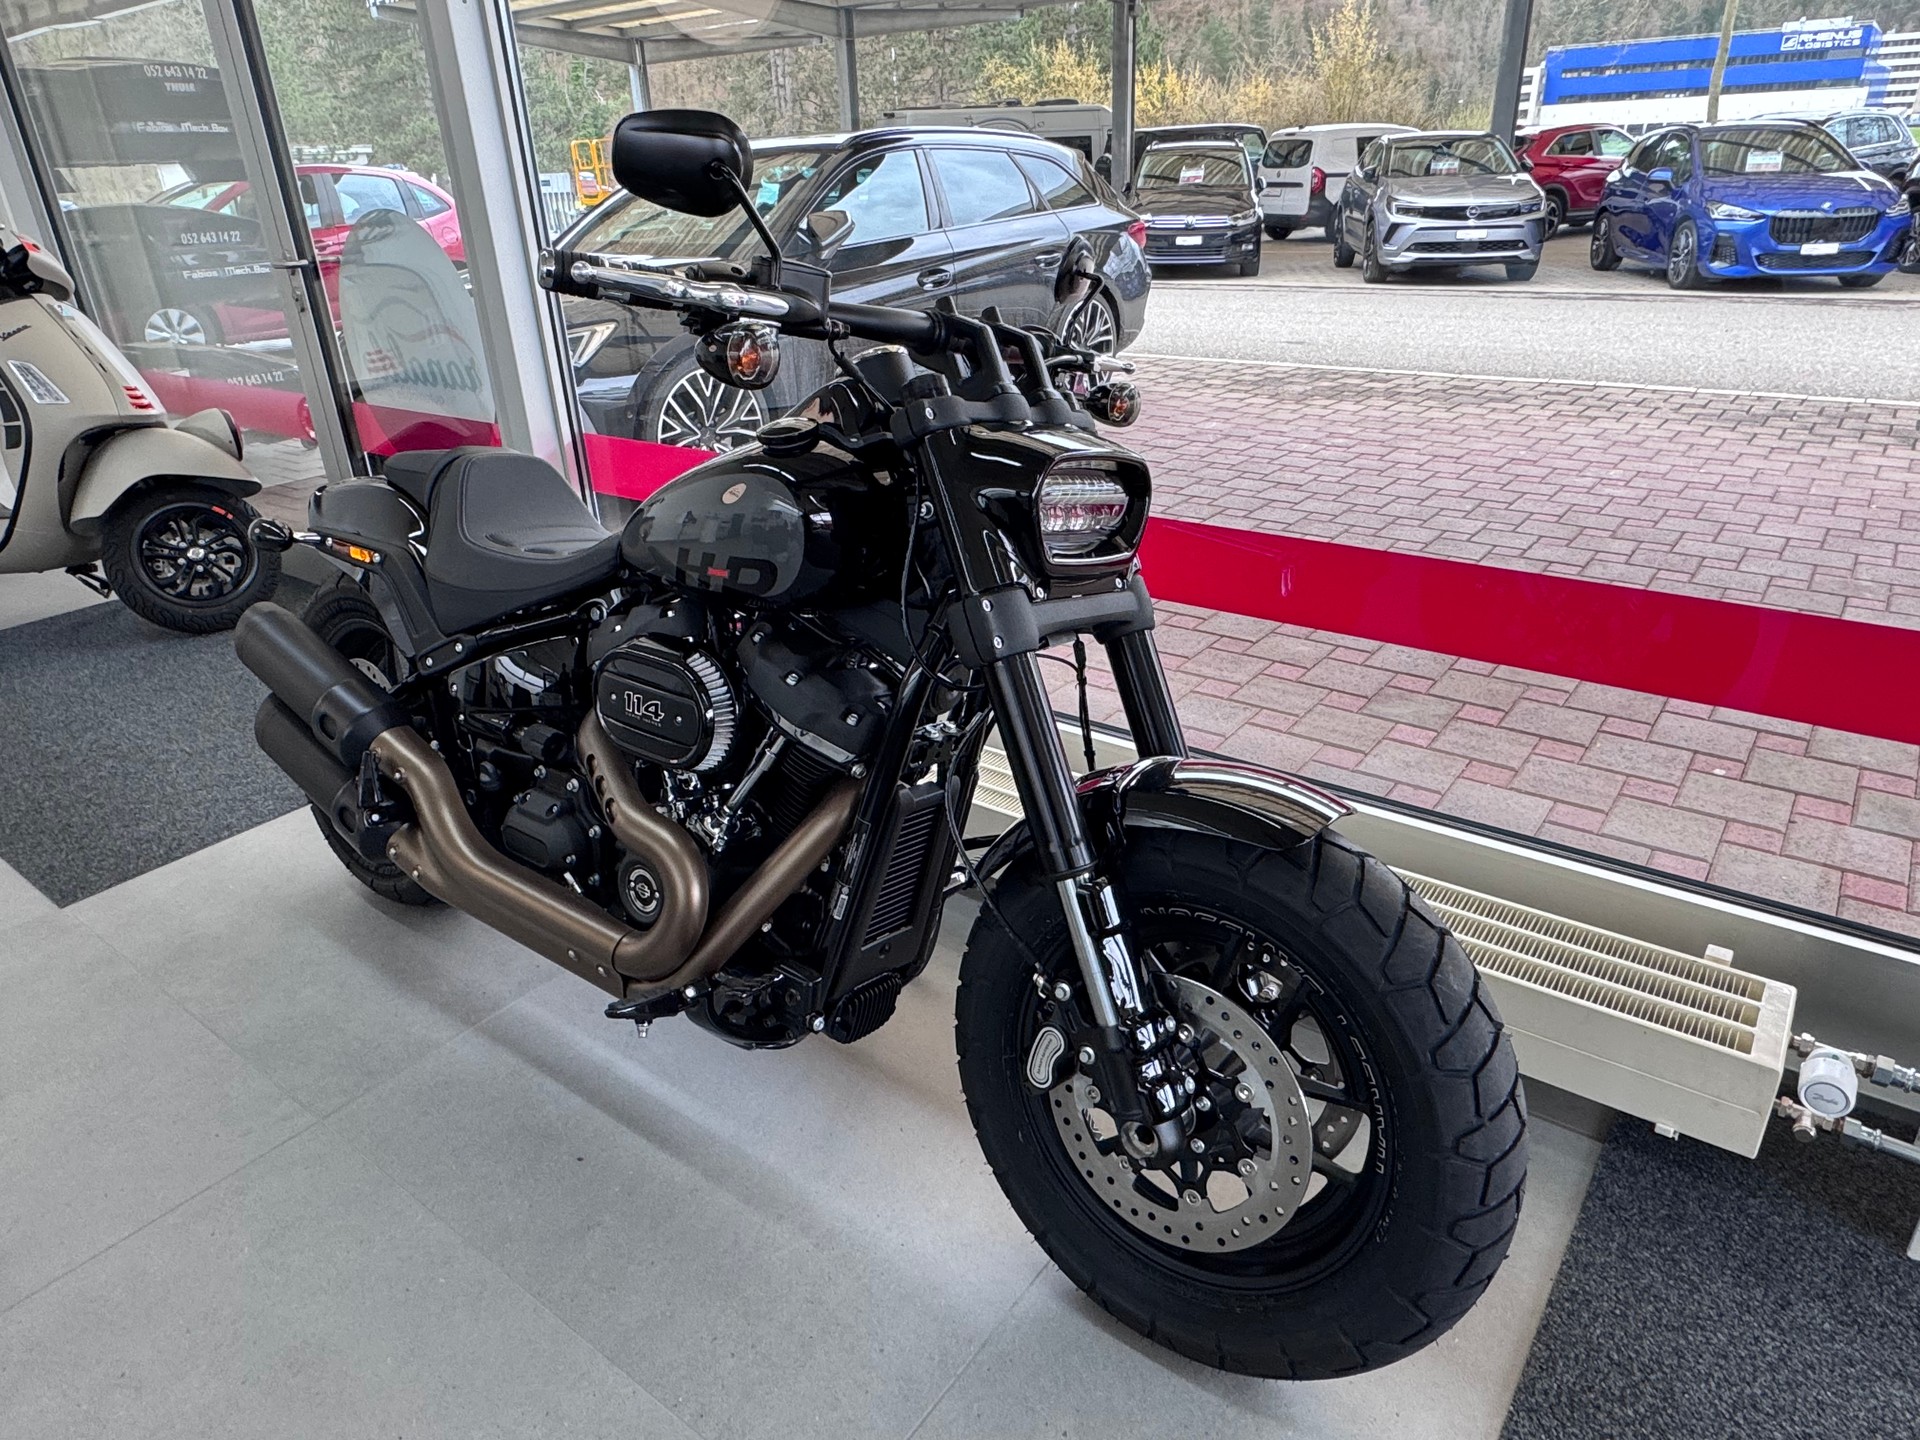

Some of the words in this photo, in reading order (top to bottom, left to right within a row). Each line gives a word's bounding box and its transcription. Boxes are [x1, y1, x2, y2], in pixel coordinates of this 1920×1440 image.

[1799, 29, 1863, 42] RHENUS
[1797, 39, 1861, 50] LOGISTICS
[143, 64, 163, 78] 052
[164, 65, 181, 78] 643
[182, 66, 195, 79] 14
[195, 67, 208, 80] 22
[181, 232, 199, 245] 052
[200, 231, 217, 244] 643
[218, 231, 229, 243] 14
[230, 230, 241, 242] 22
[182, 269, 219, 280] Fabios
[624, 691, 665, 722] 114
